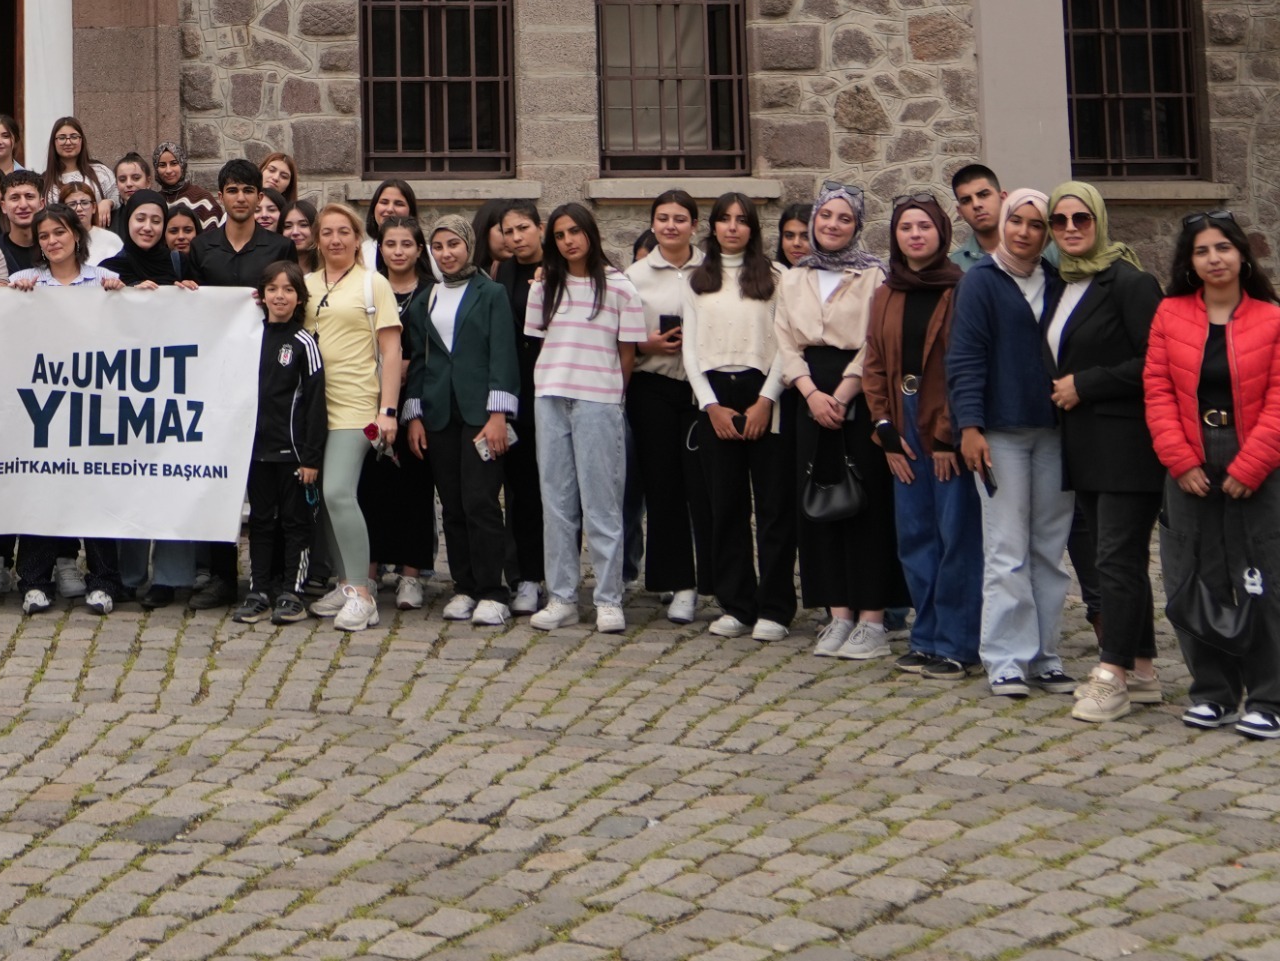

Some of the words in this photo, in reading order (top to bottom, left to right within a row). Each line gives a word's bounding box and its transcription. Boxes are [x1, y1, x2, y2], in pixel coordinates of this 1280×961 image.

[16, 387, 205, 449] YILMAZ
[83, 458, 159, 477] BELEDİYE
[162, 462, 229, 482] BAŞKANI
